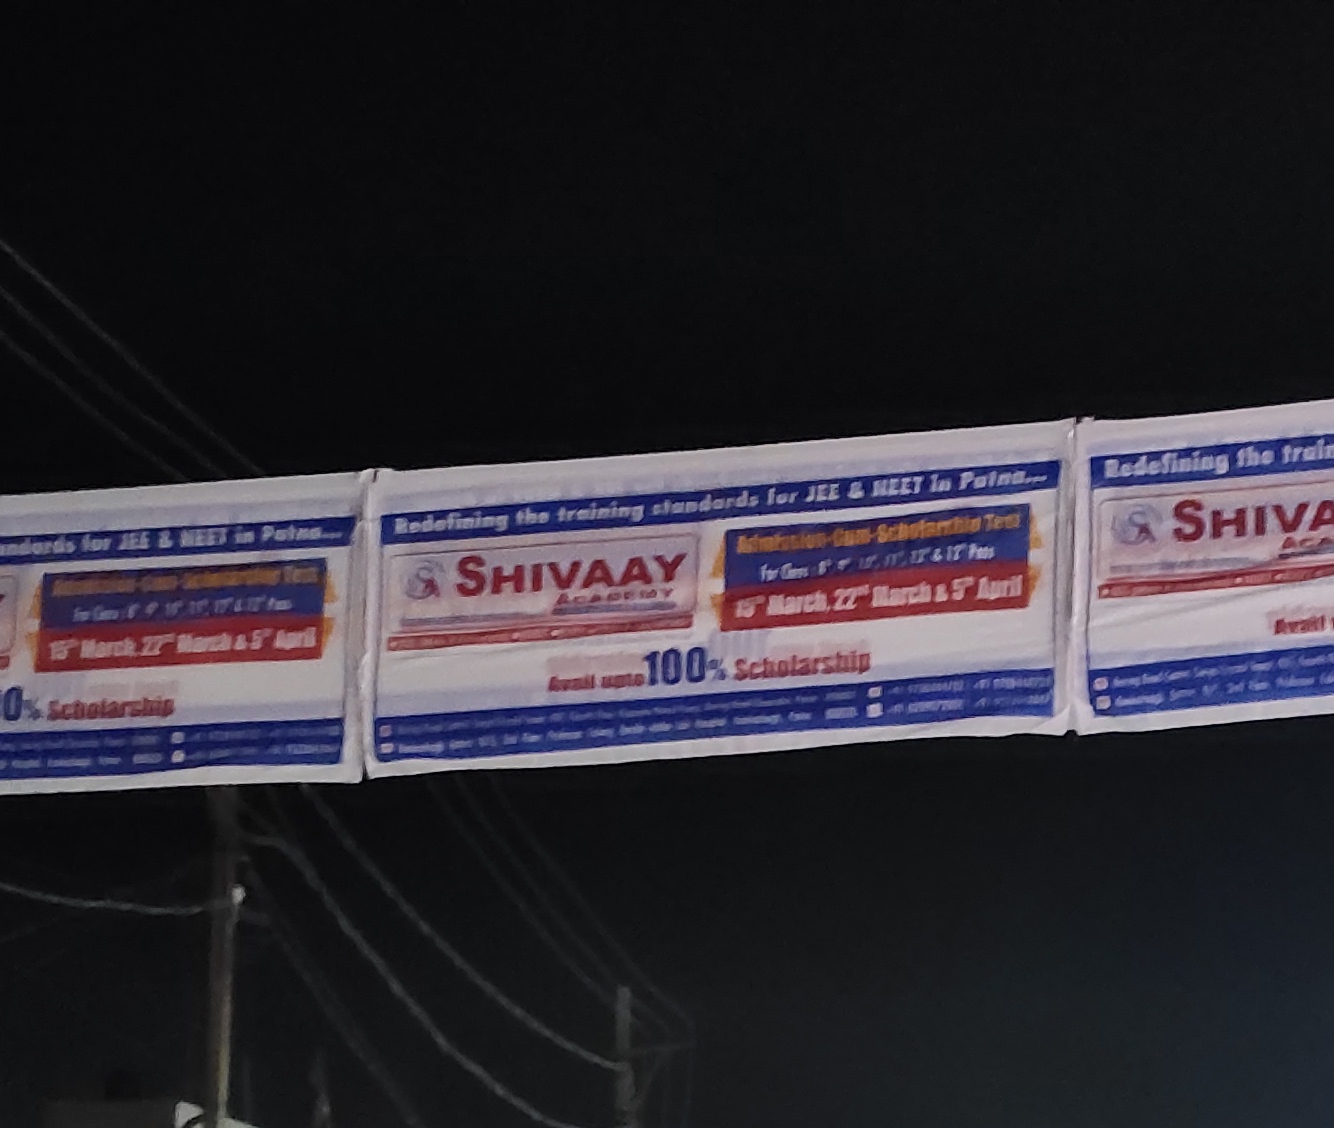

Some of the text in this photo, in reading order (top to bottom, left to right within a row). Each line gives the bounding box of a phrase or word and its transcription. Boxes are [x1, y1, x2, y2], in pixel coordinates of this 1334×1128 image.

[1104, 452, 1229, 478] Redefining
[1237, 445, 1274, 468] the
[394, 512, 508, 535] Redefining
[516, 508, 549, 525] the
[557, 500, 645, 522] training
[768, 486, 798, 505] for
[805, 483, 839, 502] JEE
[871, 475, 924, 497] NEET
[930, 474, 951, 492] in
[456, 553, 688, 598] SHIVAAY
[871, 581, 931, 608] March
[976, 574, 1022, 600] April
[553, 588, 674, 606] ACADEMY
[644, 647, 727, 686] 100%
[734, 650, 871, 681] Scholarship
